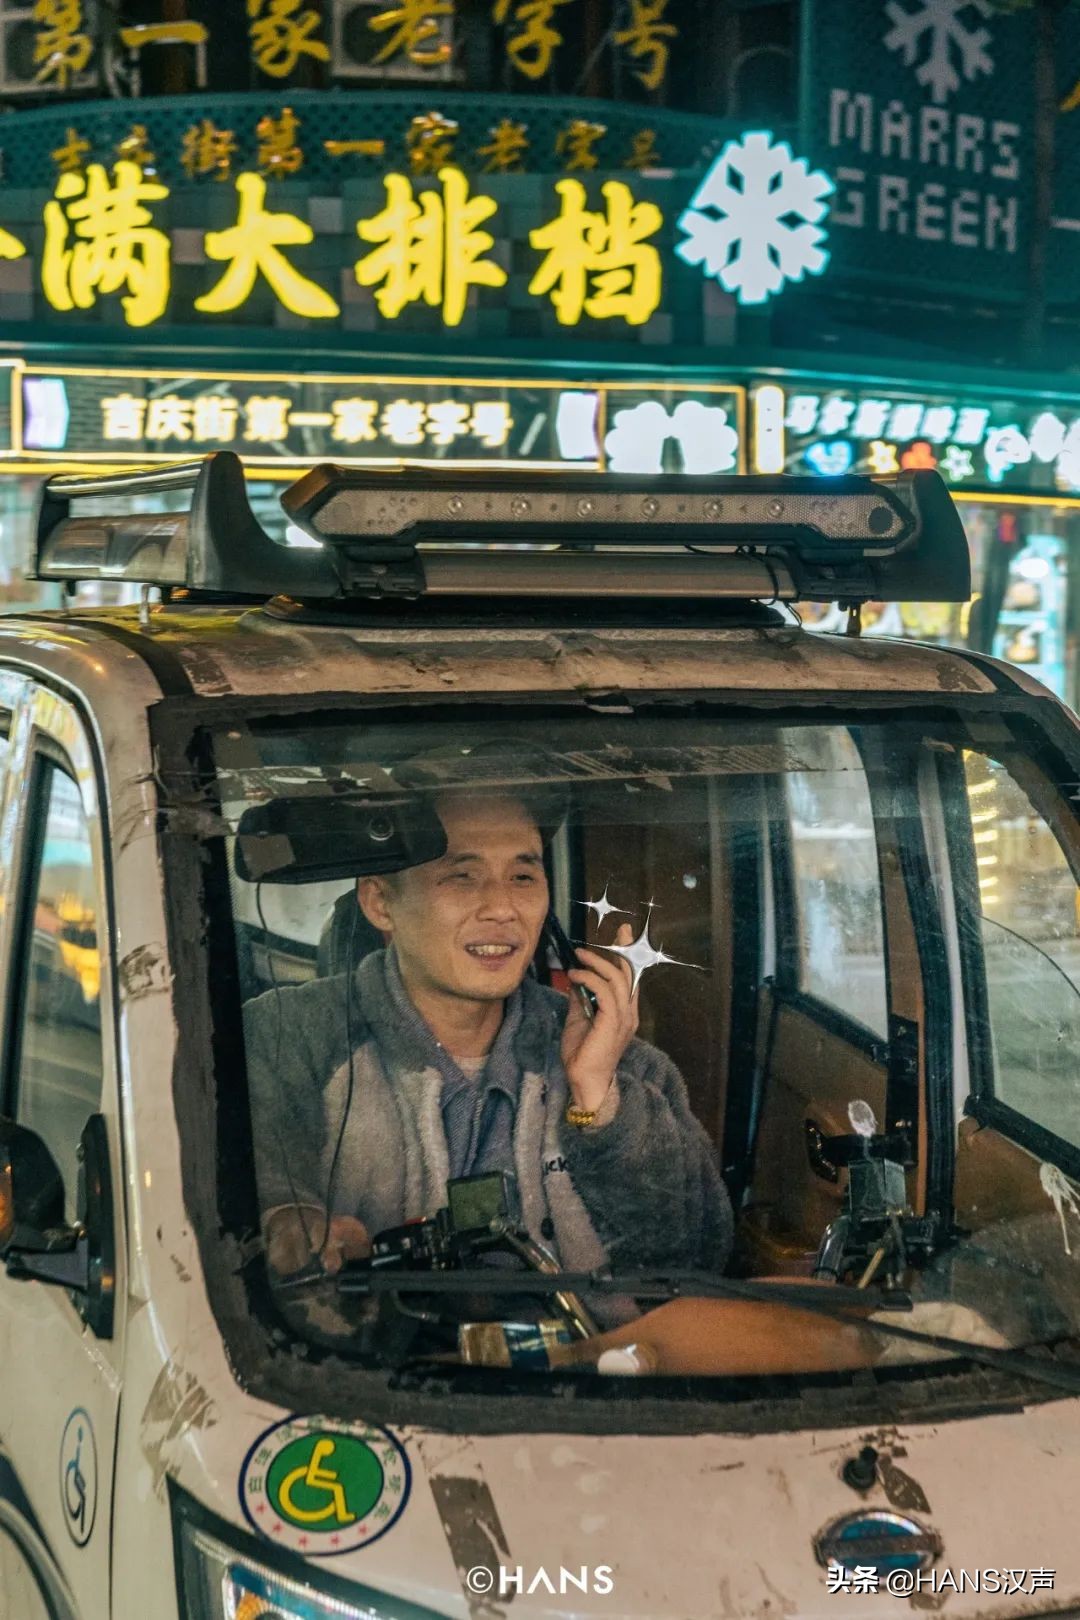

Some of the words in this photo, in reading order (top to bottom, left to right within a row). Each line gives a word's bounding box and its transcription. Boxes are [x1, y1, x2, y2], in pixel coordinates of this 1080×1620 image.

[828, 88, 1020, 180] MARRS
[0, 160, 663, 327] 满大排档
[830, 167, 1017, 253] GREEN
[101, 393, 513, 448] 吉庆街第一家老字号
